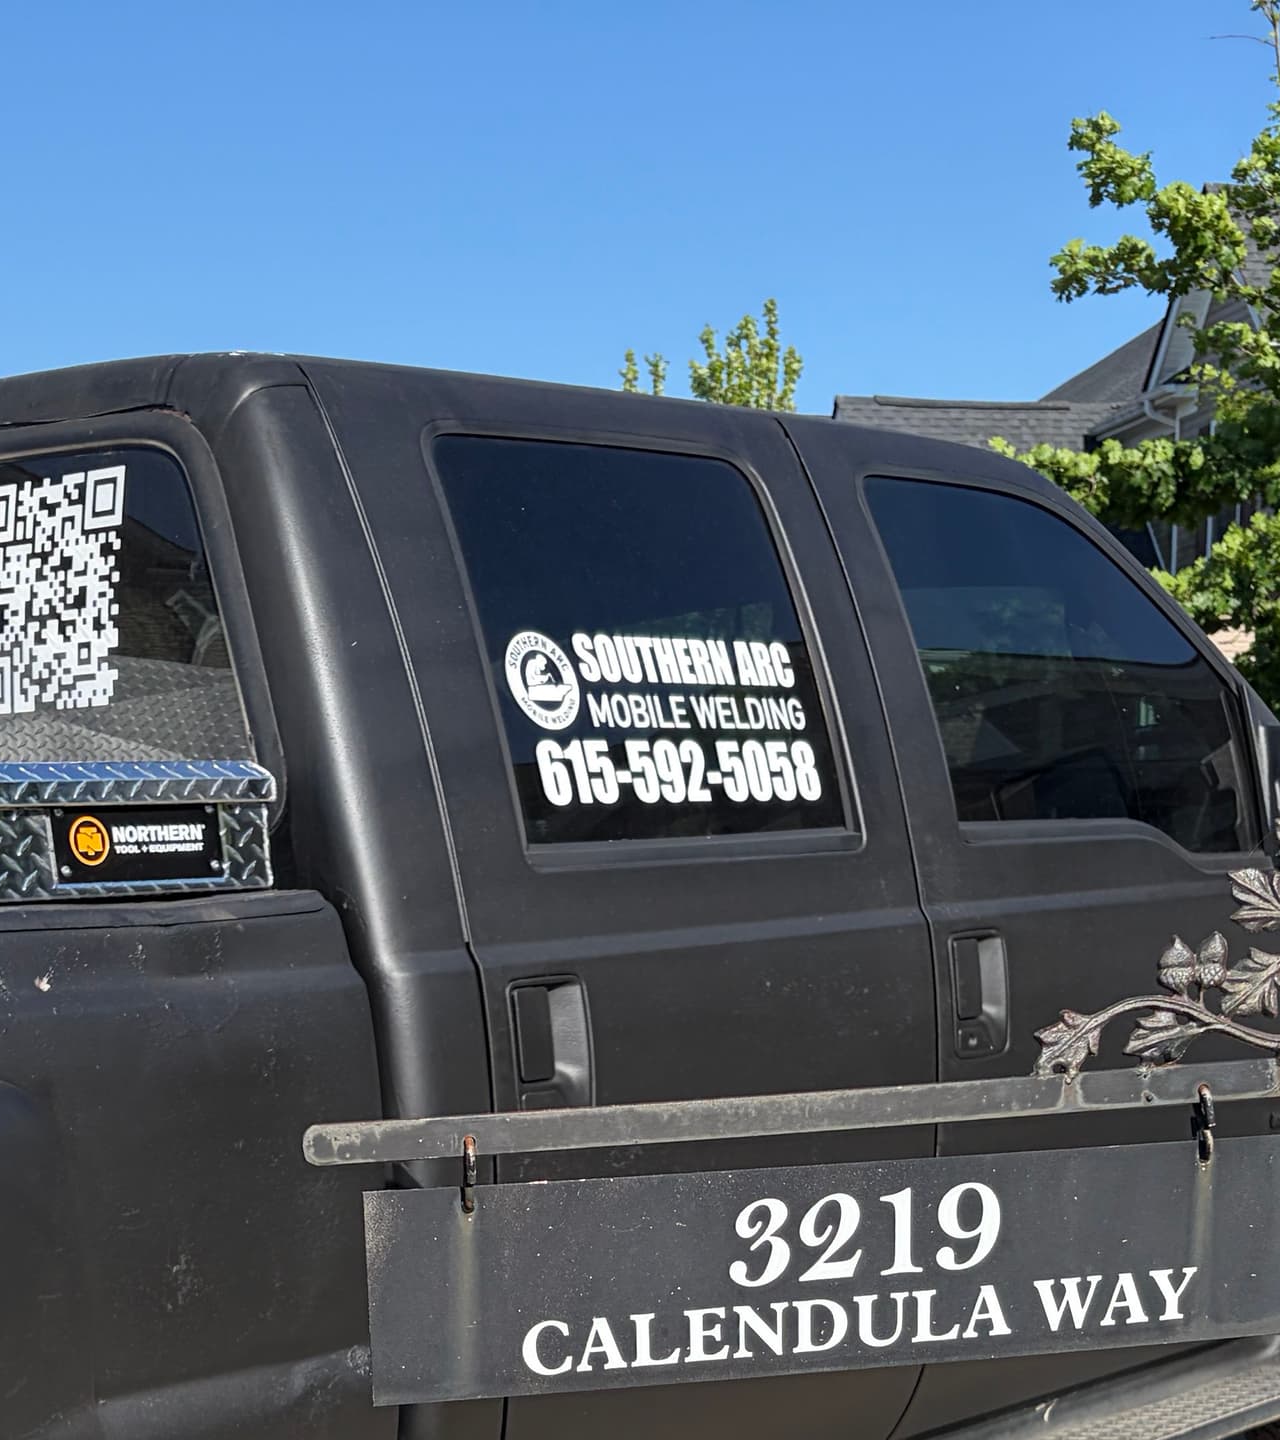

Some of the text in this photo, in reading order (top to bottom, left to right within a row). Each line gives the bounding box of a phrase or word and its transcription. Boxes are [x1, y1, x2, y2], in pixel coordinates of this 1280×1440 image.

[571, 632, 796, 688] SOUTHERN ARC
[586, 693, 807, 731] MOBILE WELDING
[535, 739, 822, 806] 615-592-5058
[728, 1182, 1002, 1289] 3219
[521, 1265, 1199, 1377] CALENDULA WAY
